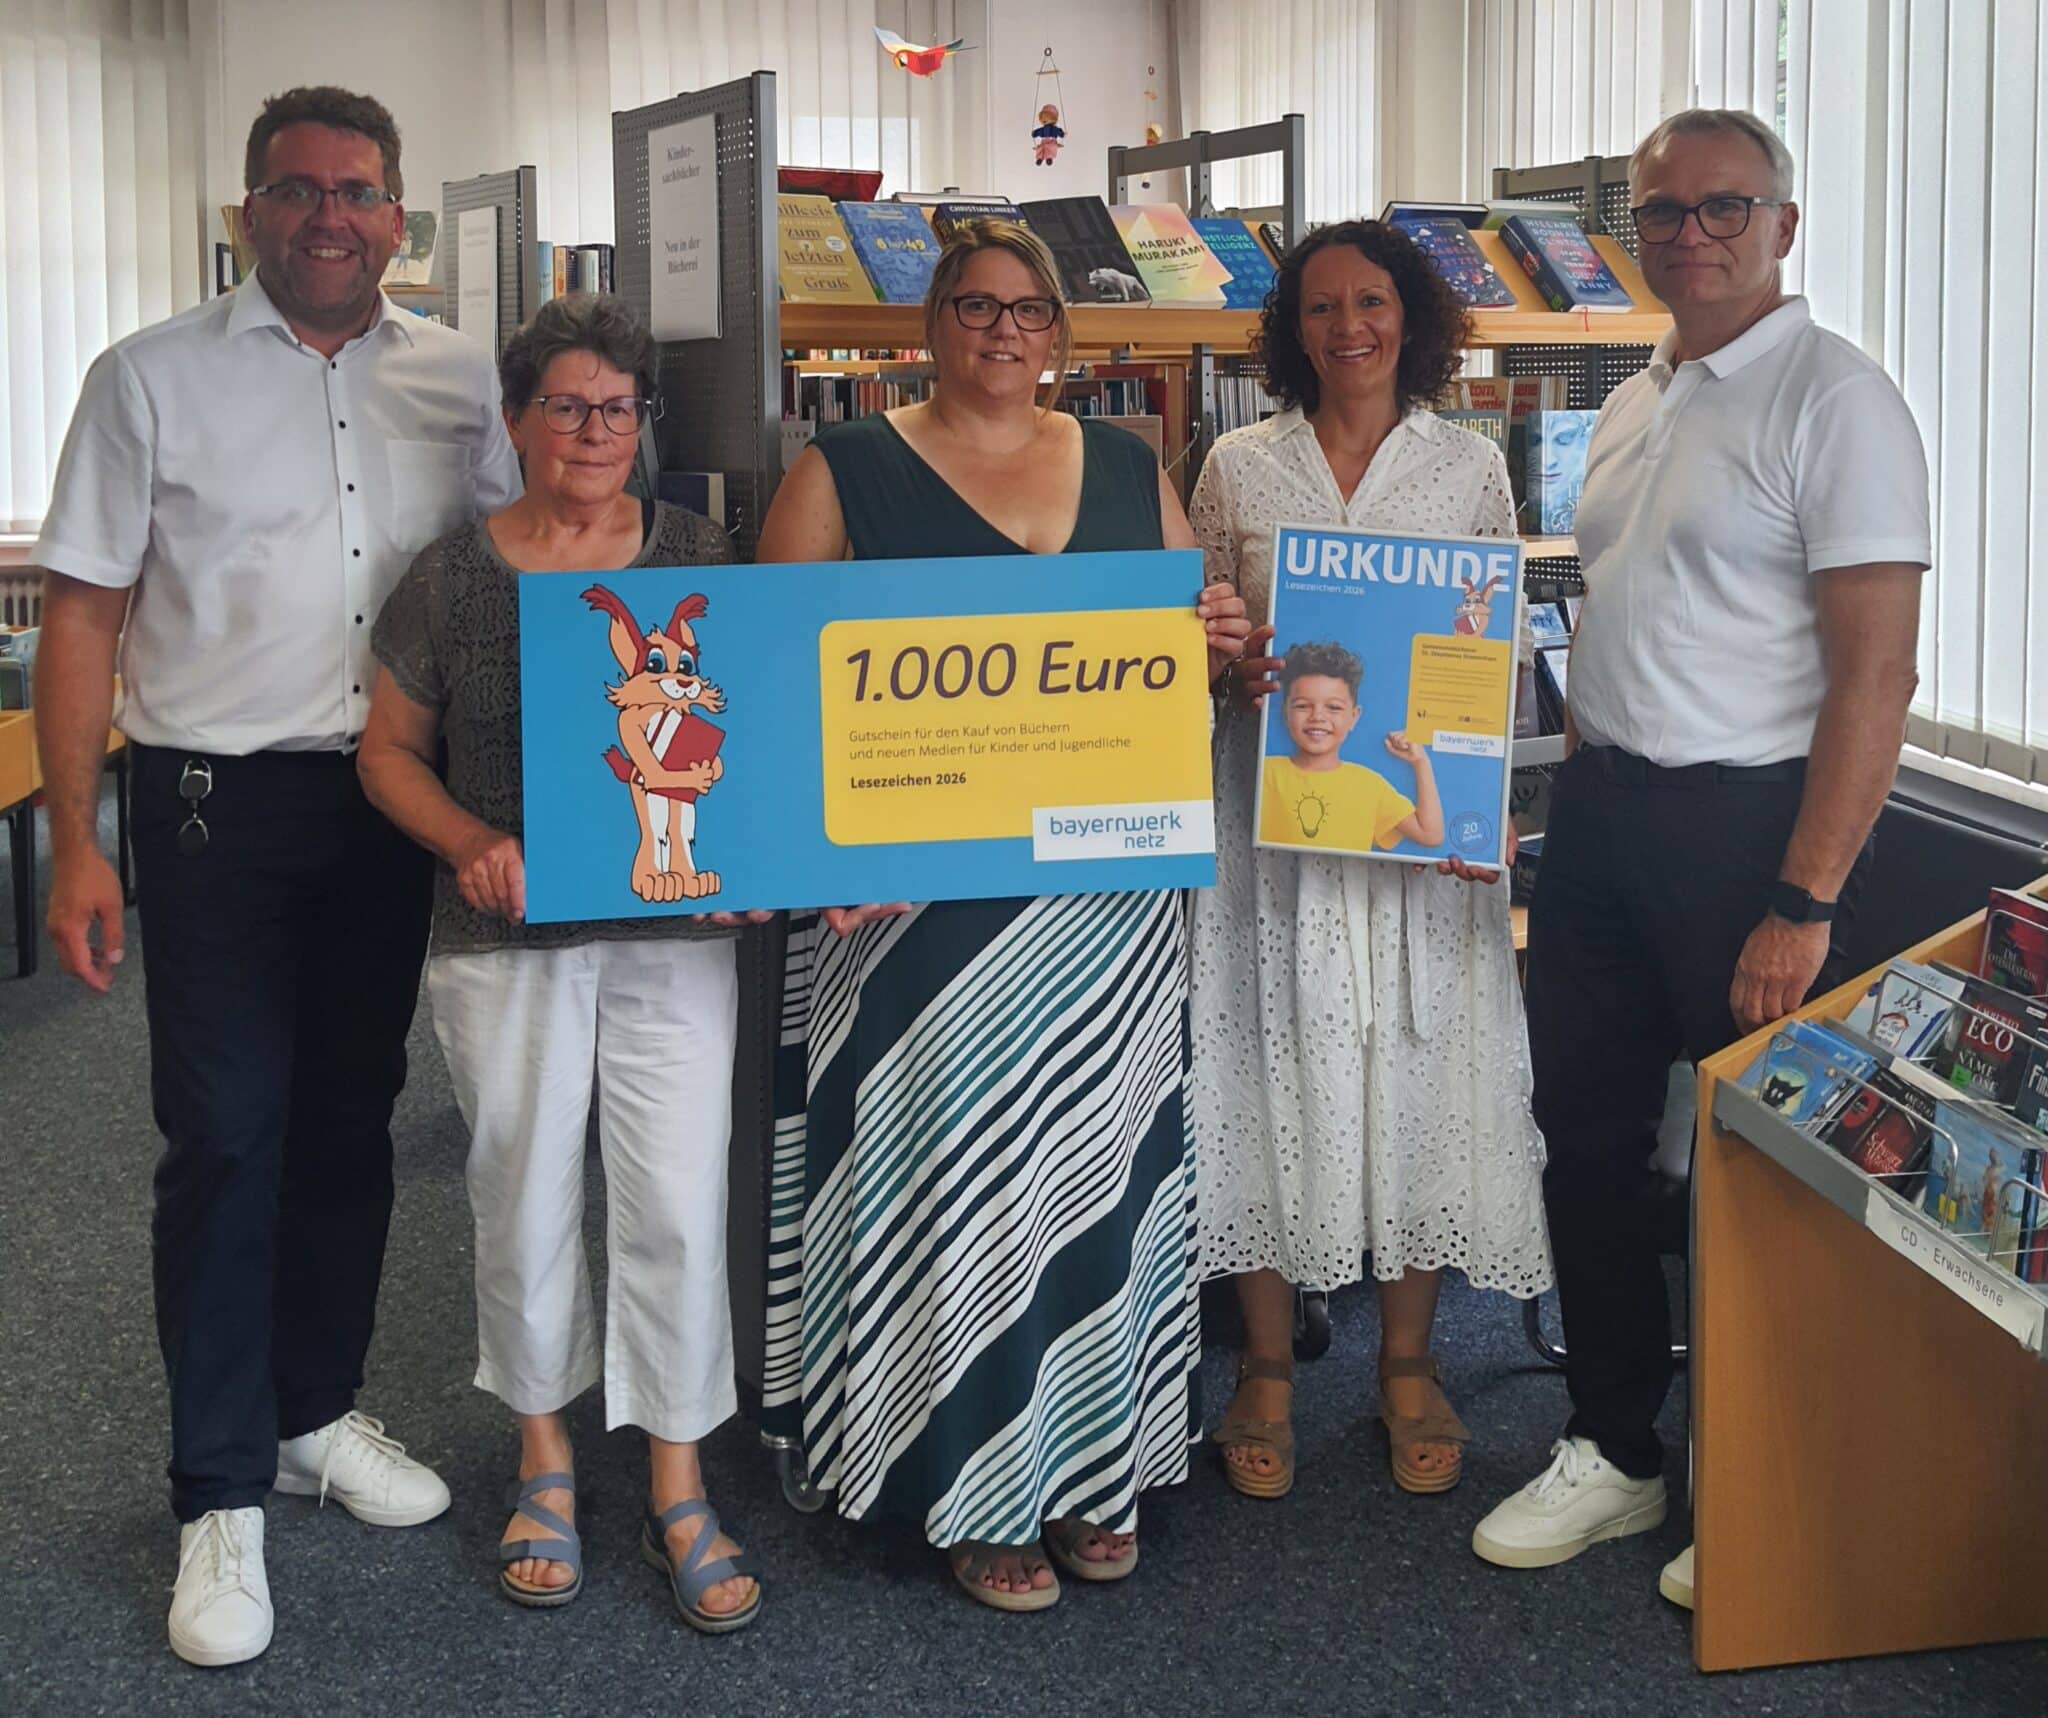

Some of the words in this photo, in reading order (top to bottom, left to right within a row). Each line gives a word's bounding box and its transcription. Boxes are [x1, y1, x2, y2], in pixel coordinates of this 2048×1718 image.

[1132, 244, 1206, 262] MURAKAMI
[1136, 236, 1187, 249] HARUKI
[1571, 280, 1613, 290] PENNY
[1286, 536, 1513, 593] URKUNDE
[1285, 580, 1341, 595] Lesezeichen
[846, 642, 1017, 702] 1.000
[1038, 641, 1177, 695] Euro
[849, 728, 912, 743] Gutschein
[914, 726, 932, 740] für
[935, 726, 960, 739] den
[962, 724, 991, 737] Kauf
[994, 725, 1016, 736] von
[1019, 721, 1071, 735] Büchern
[849, 747, 873, 760] und
[876, 747, 916, 760] neuen
[918, 743, 965, 758] Medien
[968, 742, 986, 755] für
[989, 740, 1030, 754] Kinder
[1032, 739, 1057, 752] und
[1060, 735, 1132, 754] Jugendliche
[850, 774, 932, 790] Lesezeichen
[935, 772, 967, 786] 2026
[1049, 810, 1182, 837] bayernwerk
[1463, 822, 1479, 834] 20
[1124, 833, 1166, 849] netz
[1967, 1014, 2014, 1053] ECO
[1972, 1072, 1999, 1093] OSE
[1901, 1226, 1918, 1247] CD
[1932, 1247, 2004, 1307] Erwachsene
